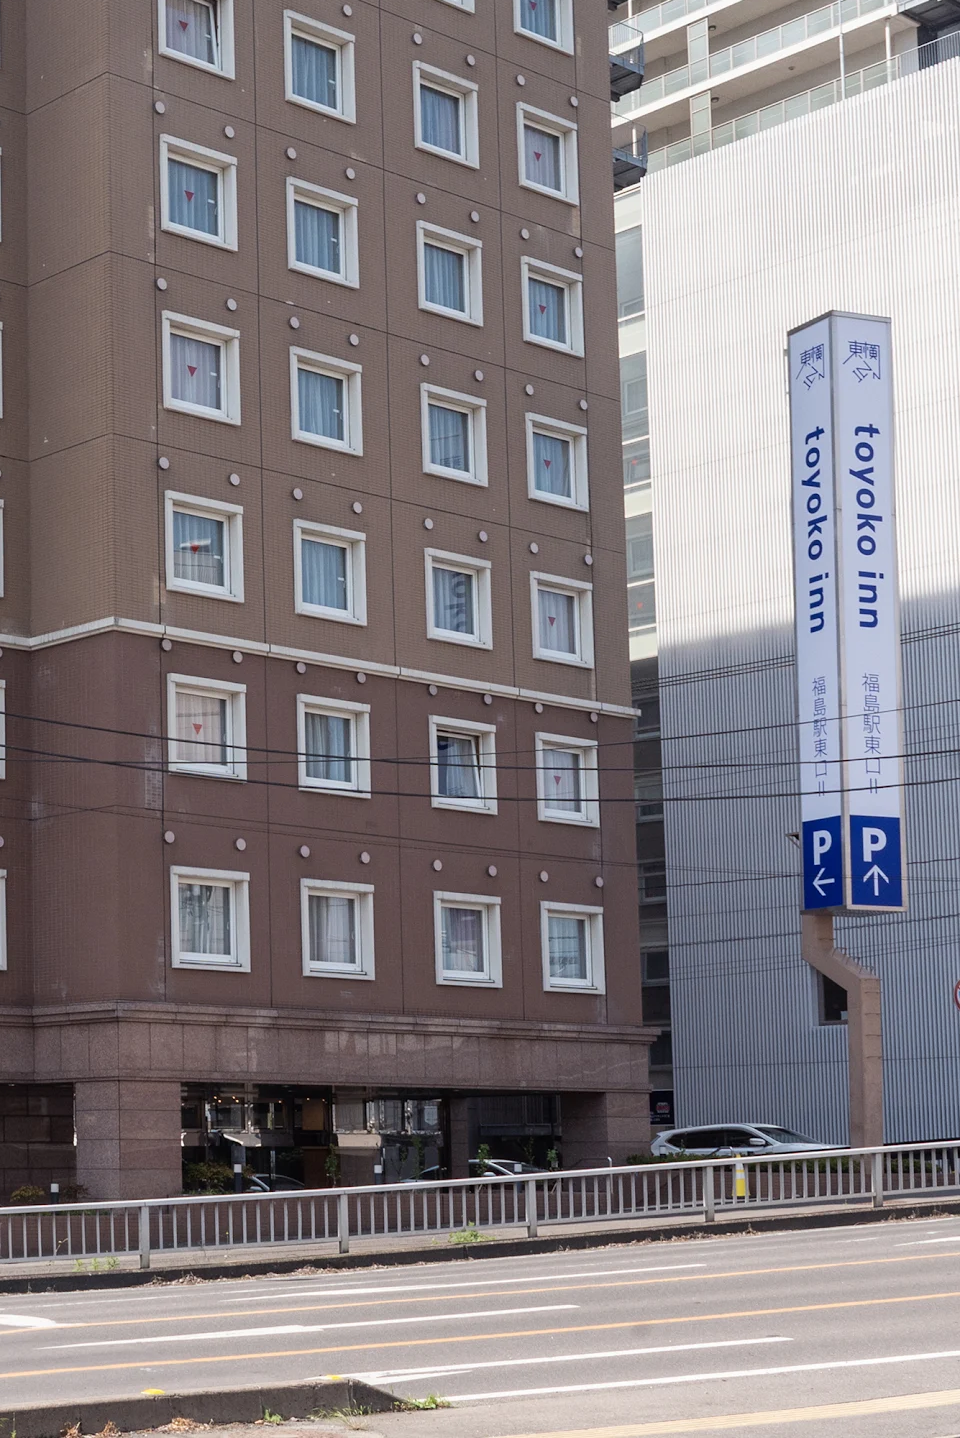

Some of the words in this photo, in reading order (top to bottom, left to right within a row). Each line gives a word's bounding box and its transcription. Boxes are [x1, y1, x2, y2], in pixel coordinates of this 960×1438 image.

[801, 426, 828, 561] toyoko
[849, 423, 883, 556] toyoko
[809, 572, 829, 633] inn
[858, 570, 884, 628] inn
[812, 829, 832, 866] P
[862, 827, 887, 862] P
